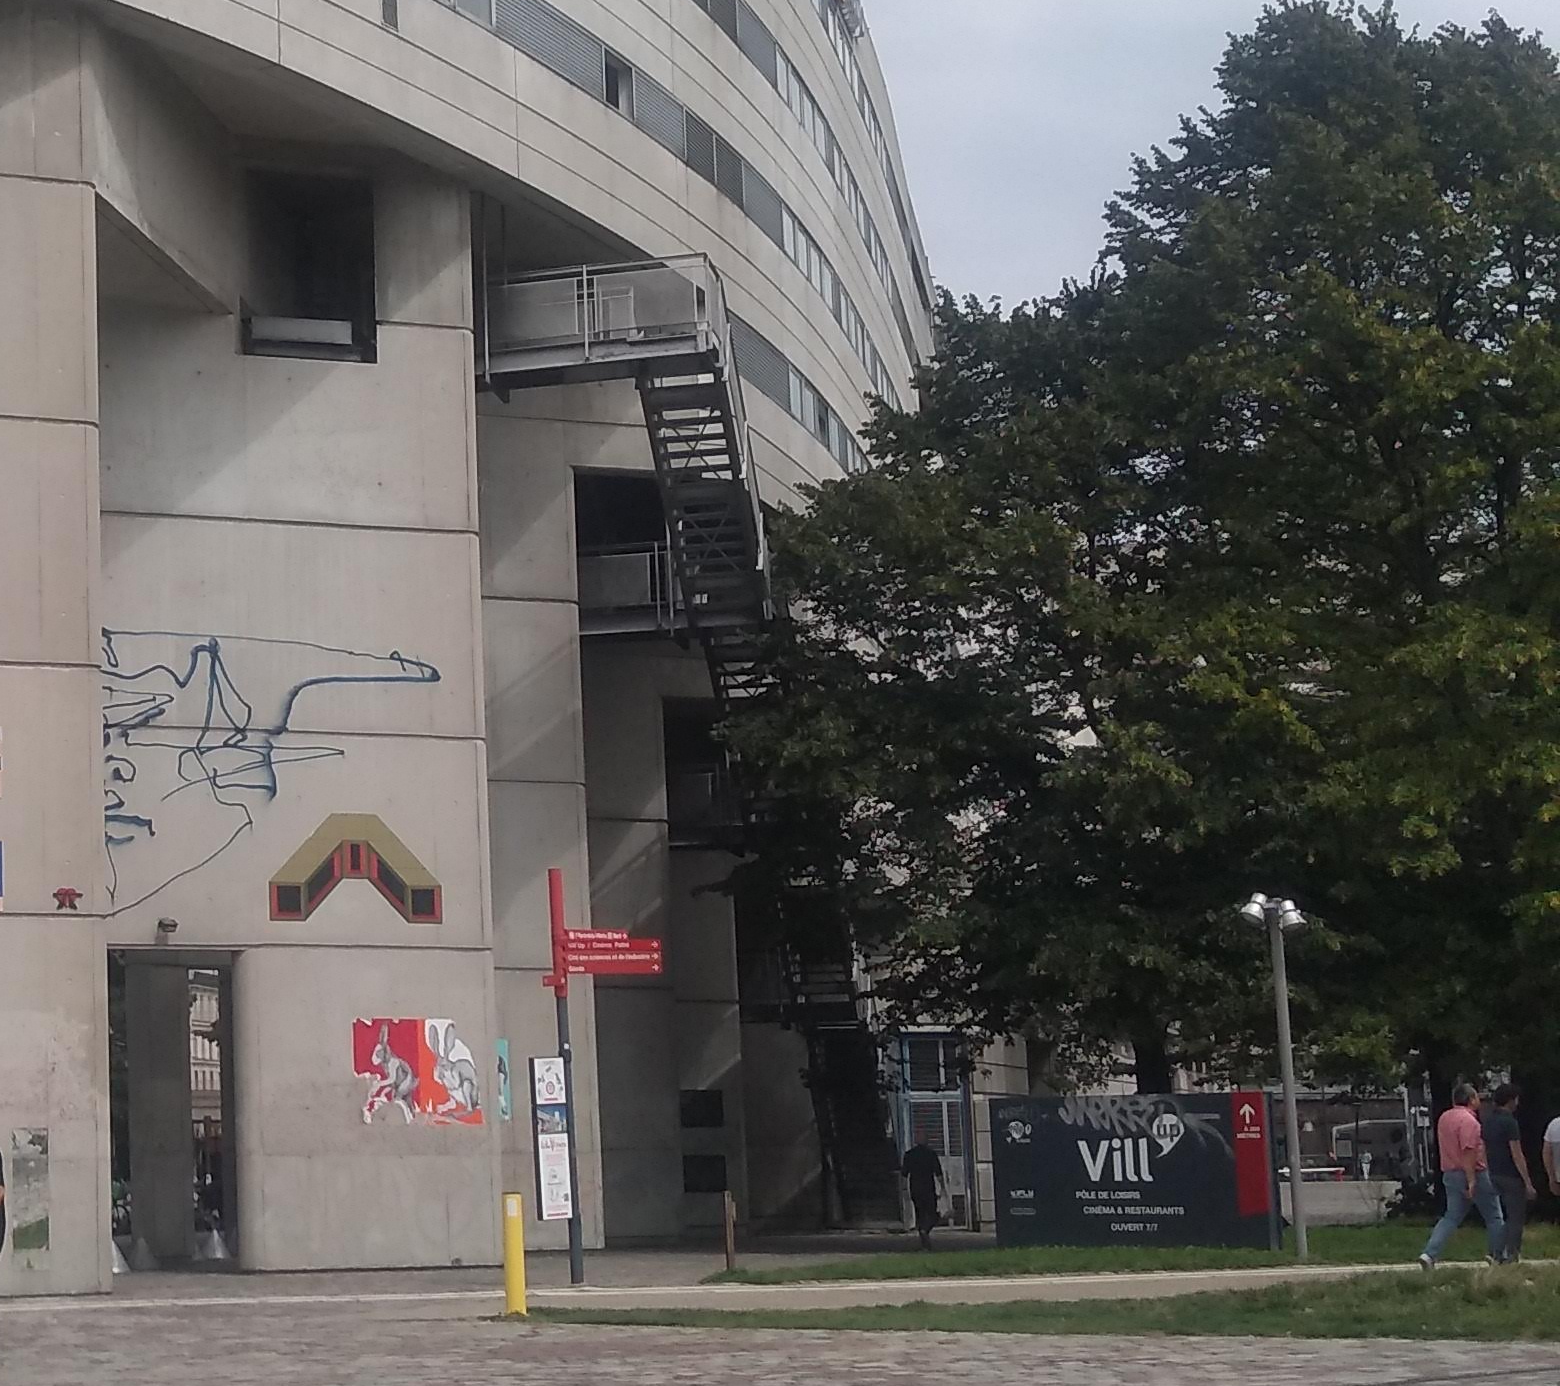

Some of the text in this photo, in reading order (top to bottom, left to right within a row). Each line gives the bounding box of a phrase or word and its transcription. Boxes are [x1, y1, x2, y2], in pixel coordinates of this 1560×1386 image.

[1077, 1137, 1154, 1182] Vill
[1075, 1189, 1141, 1199] PÔLE DE LOISIRS
[1083, 1205, 1185, 1215] CINÉMA & RESTAURANTS
[1110, 1222, 1159, 1231] OUVERT 7/7
